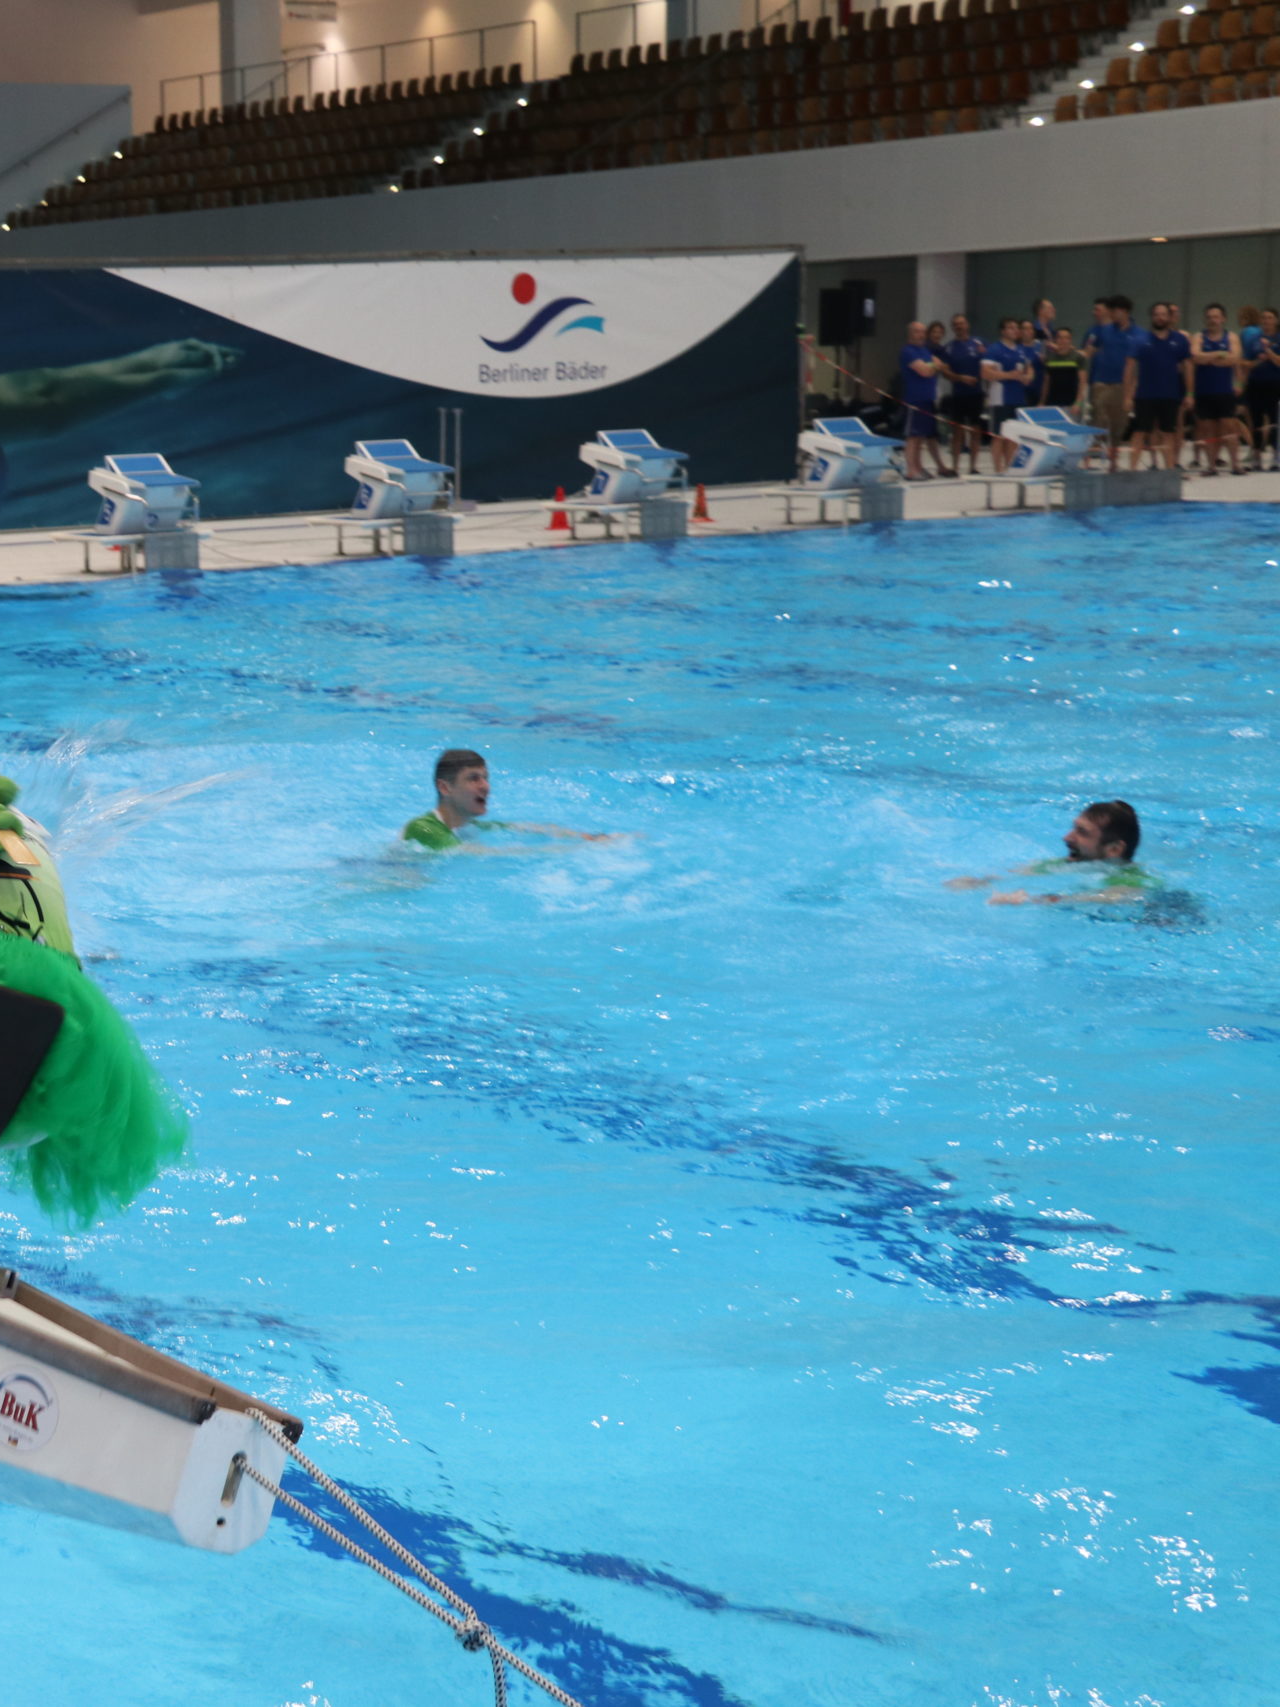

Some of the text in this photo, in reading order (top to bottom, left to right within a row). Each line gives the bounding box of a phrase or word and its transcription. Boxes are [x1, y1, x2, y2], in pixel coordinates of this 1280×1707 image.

[478, 361, 607, 383] Berliner Bäder
[0, 1389, 45, 1434] BuK
